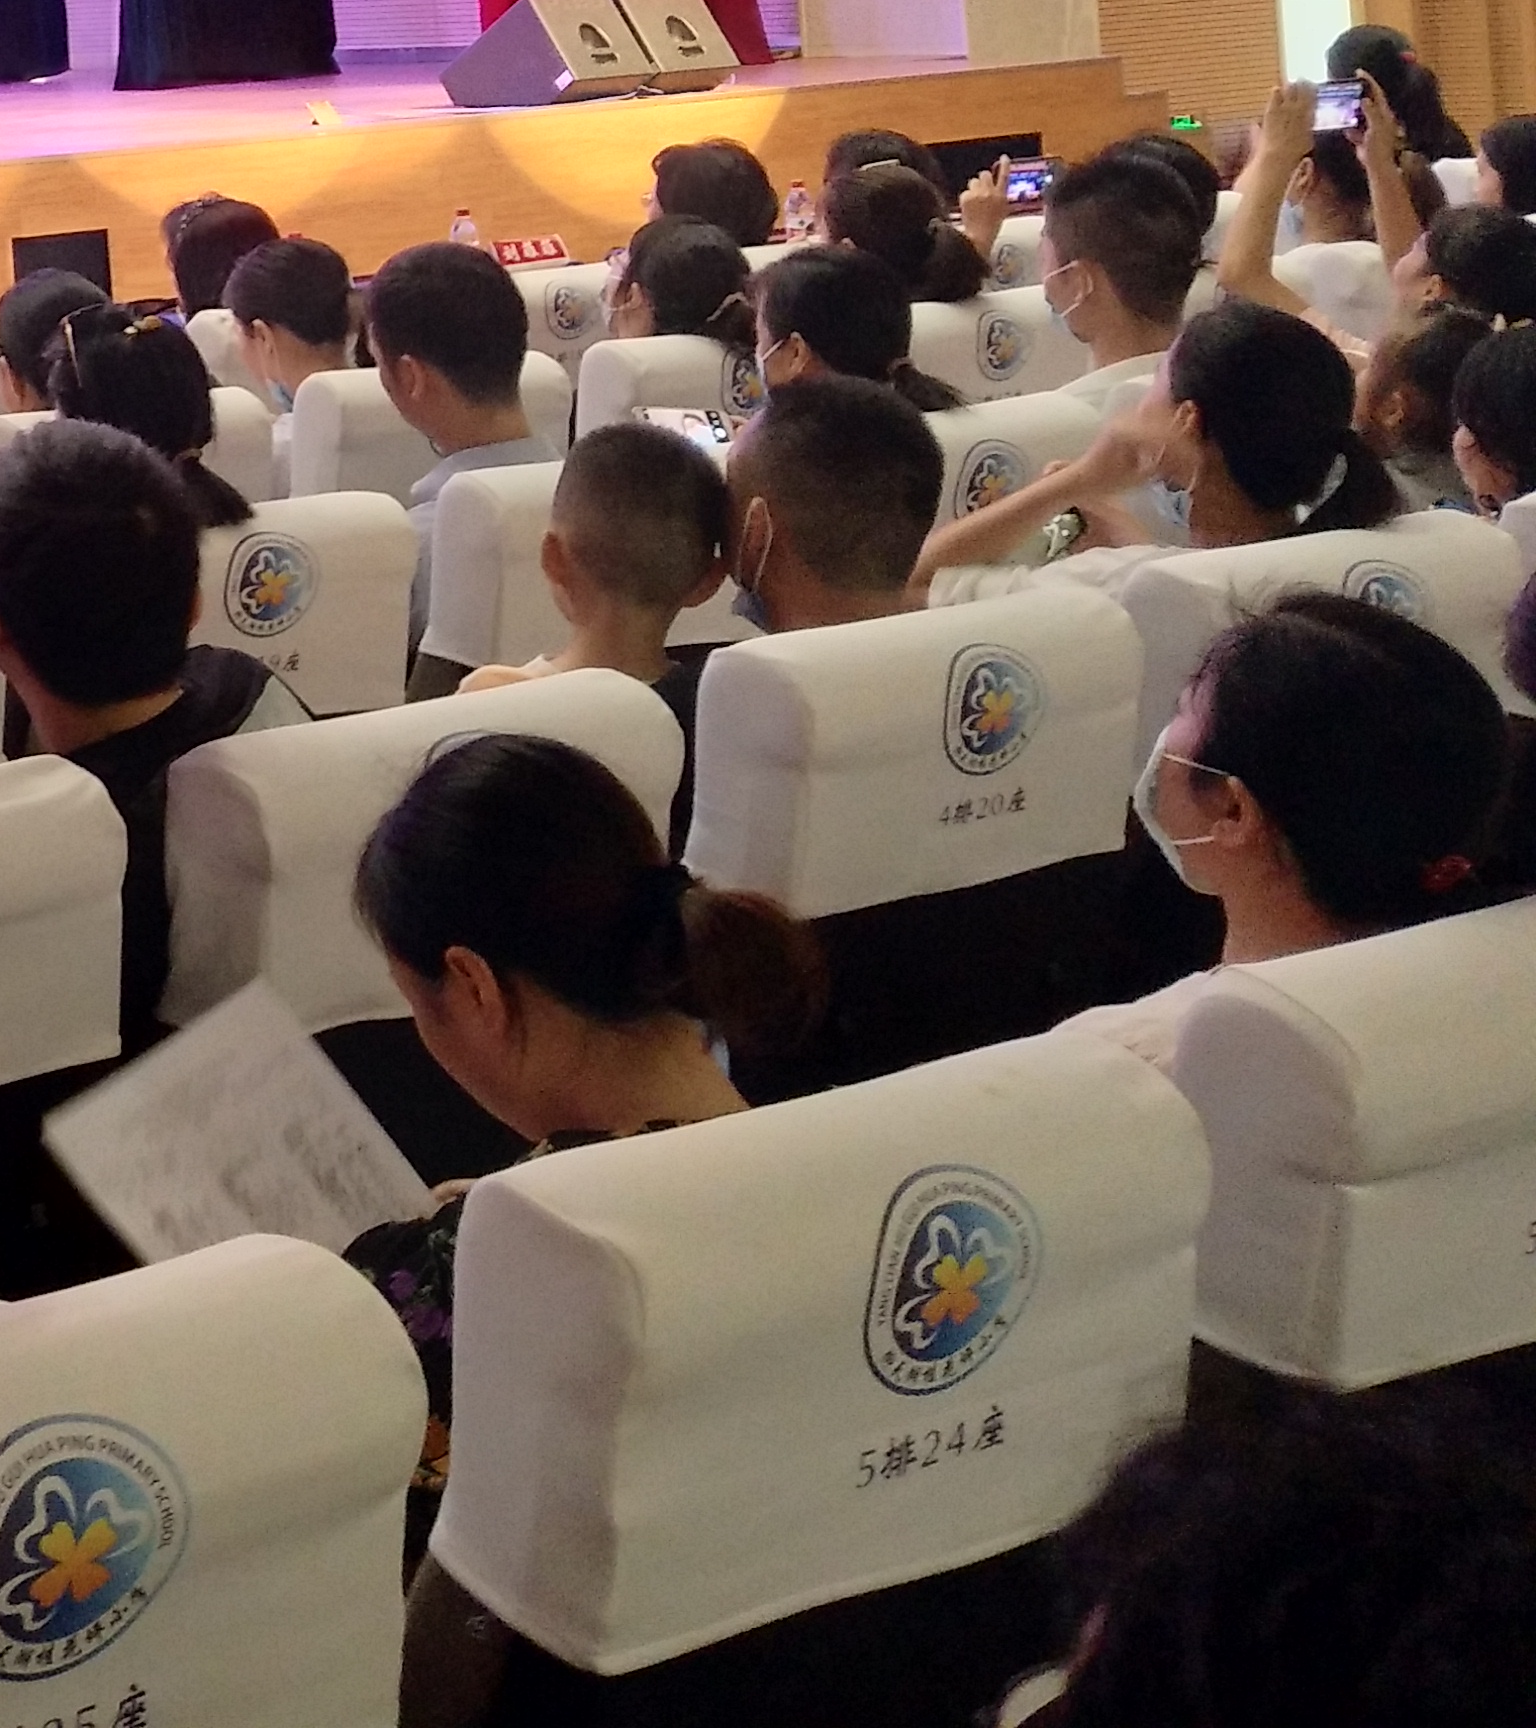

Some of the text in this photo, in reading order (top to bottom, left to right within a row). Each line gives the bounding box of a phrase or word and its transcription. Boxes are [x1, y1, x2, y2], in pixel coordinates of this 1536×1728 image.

[939, 787, 1026, 826] 4排20座
[856, 1405, 1004, 1489] 5排24座
[56, 1435, 95, 1451] PING
[98, 1438, 160, 1486] PRIMARY
[155, 1486, 175, 1550] SCHOOL
